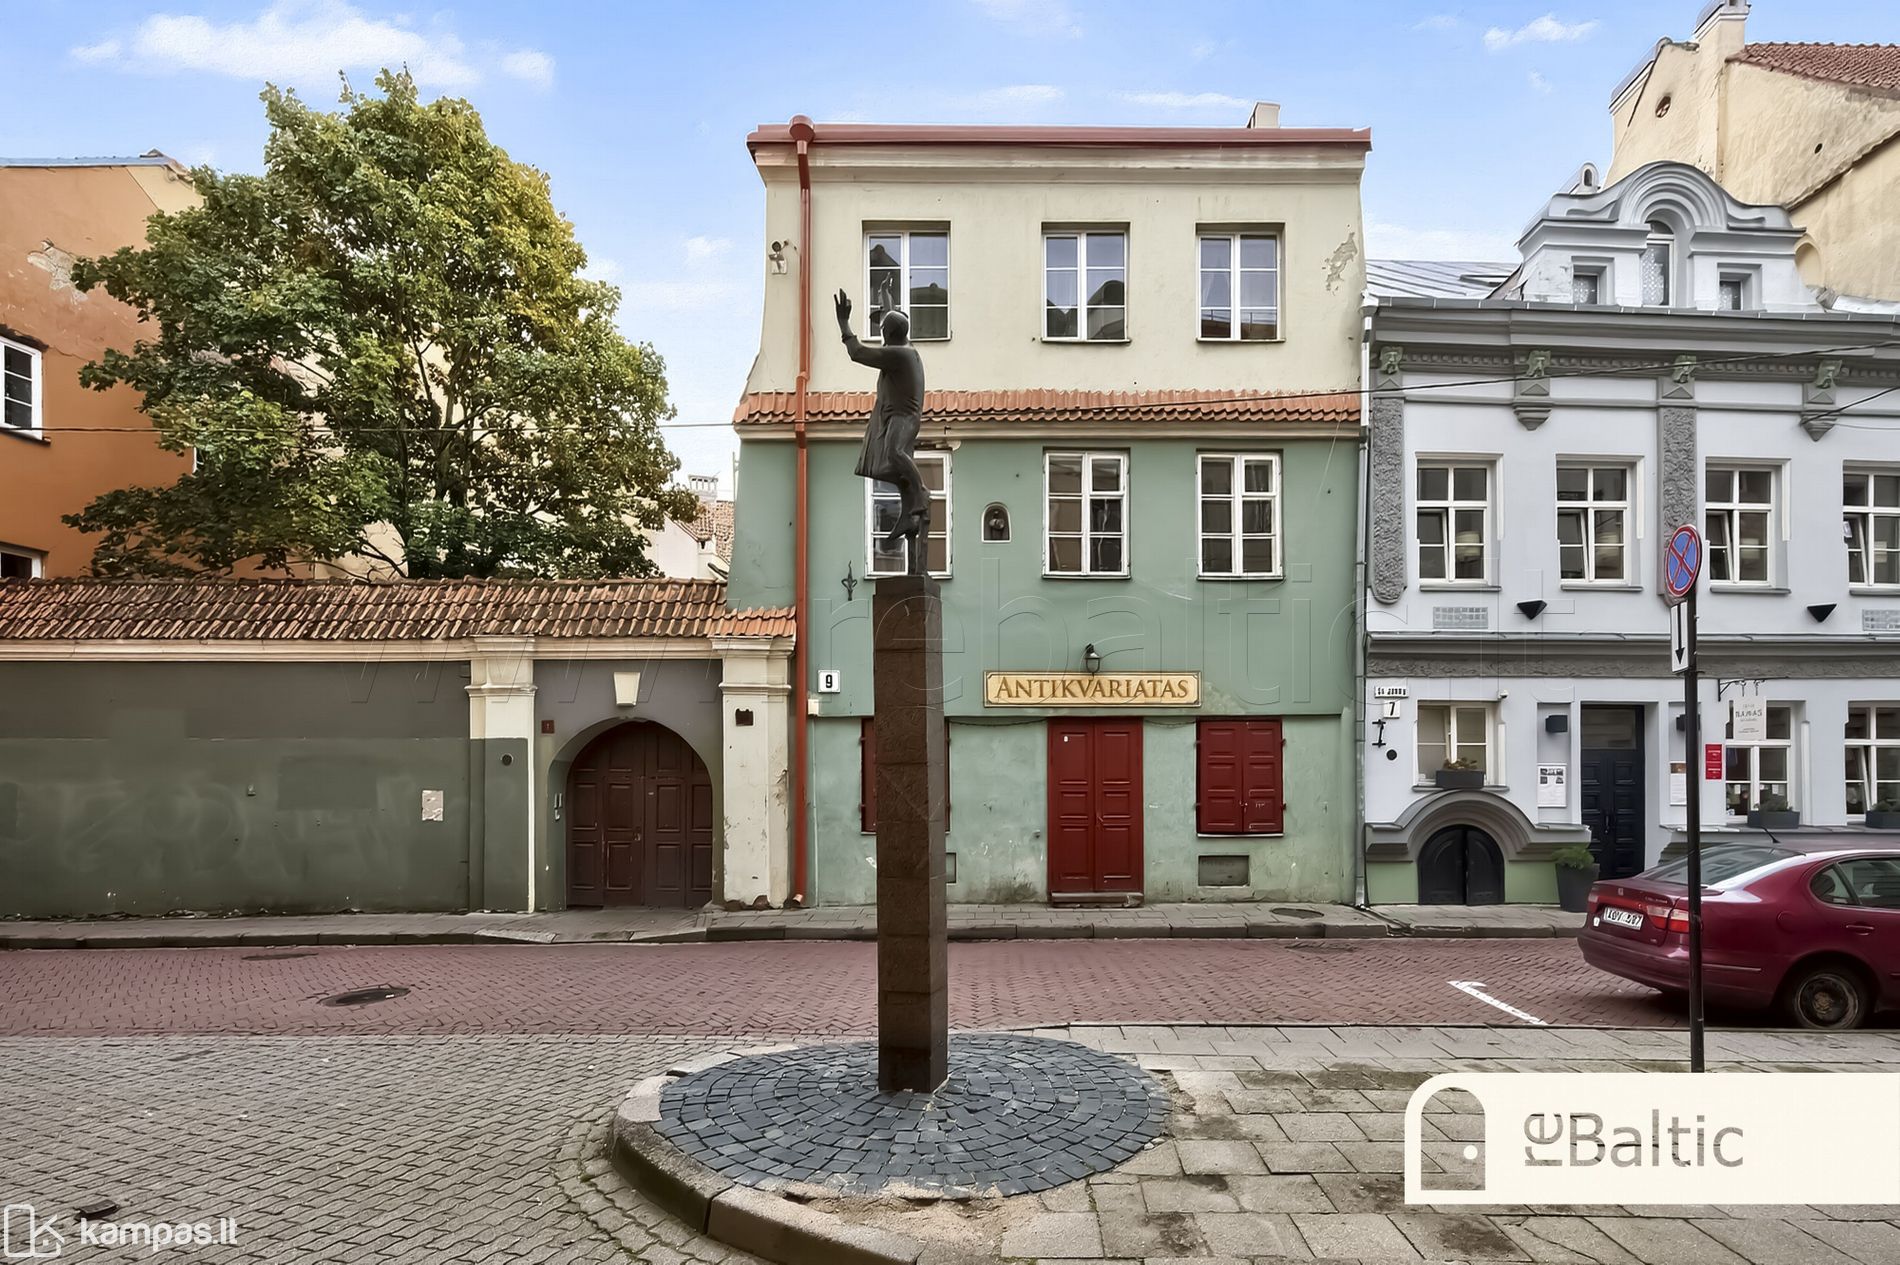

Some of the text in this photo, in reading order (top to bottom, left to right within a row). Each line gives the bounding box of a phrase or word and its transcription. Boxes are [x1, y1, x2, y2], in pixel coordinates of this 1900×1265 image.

[824, 675, 833, 689] 9
[993, 675, 1190, 699] ANTIKVARIATAS
[1389, 701, 1396, 716] 7
